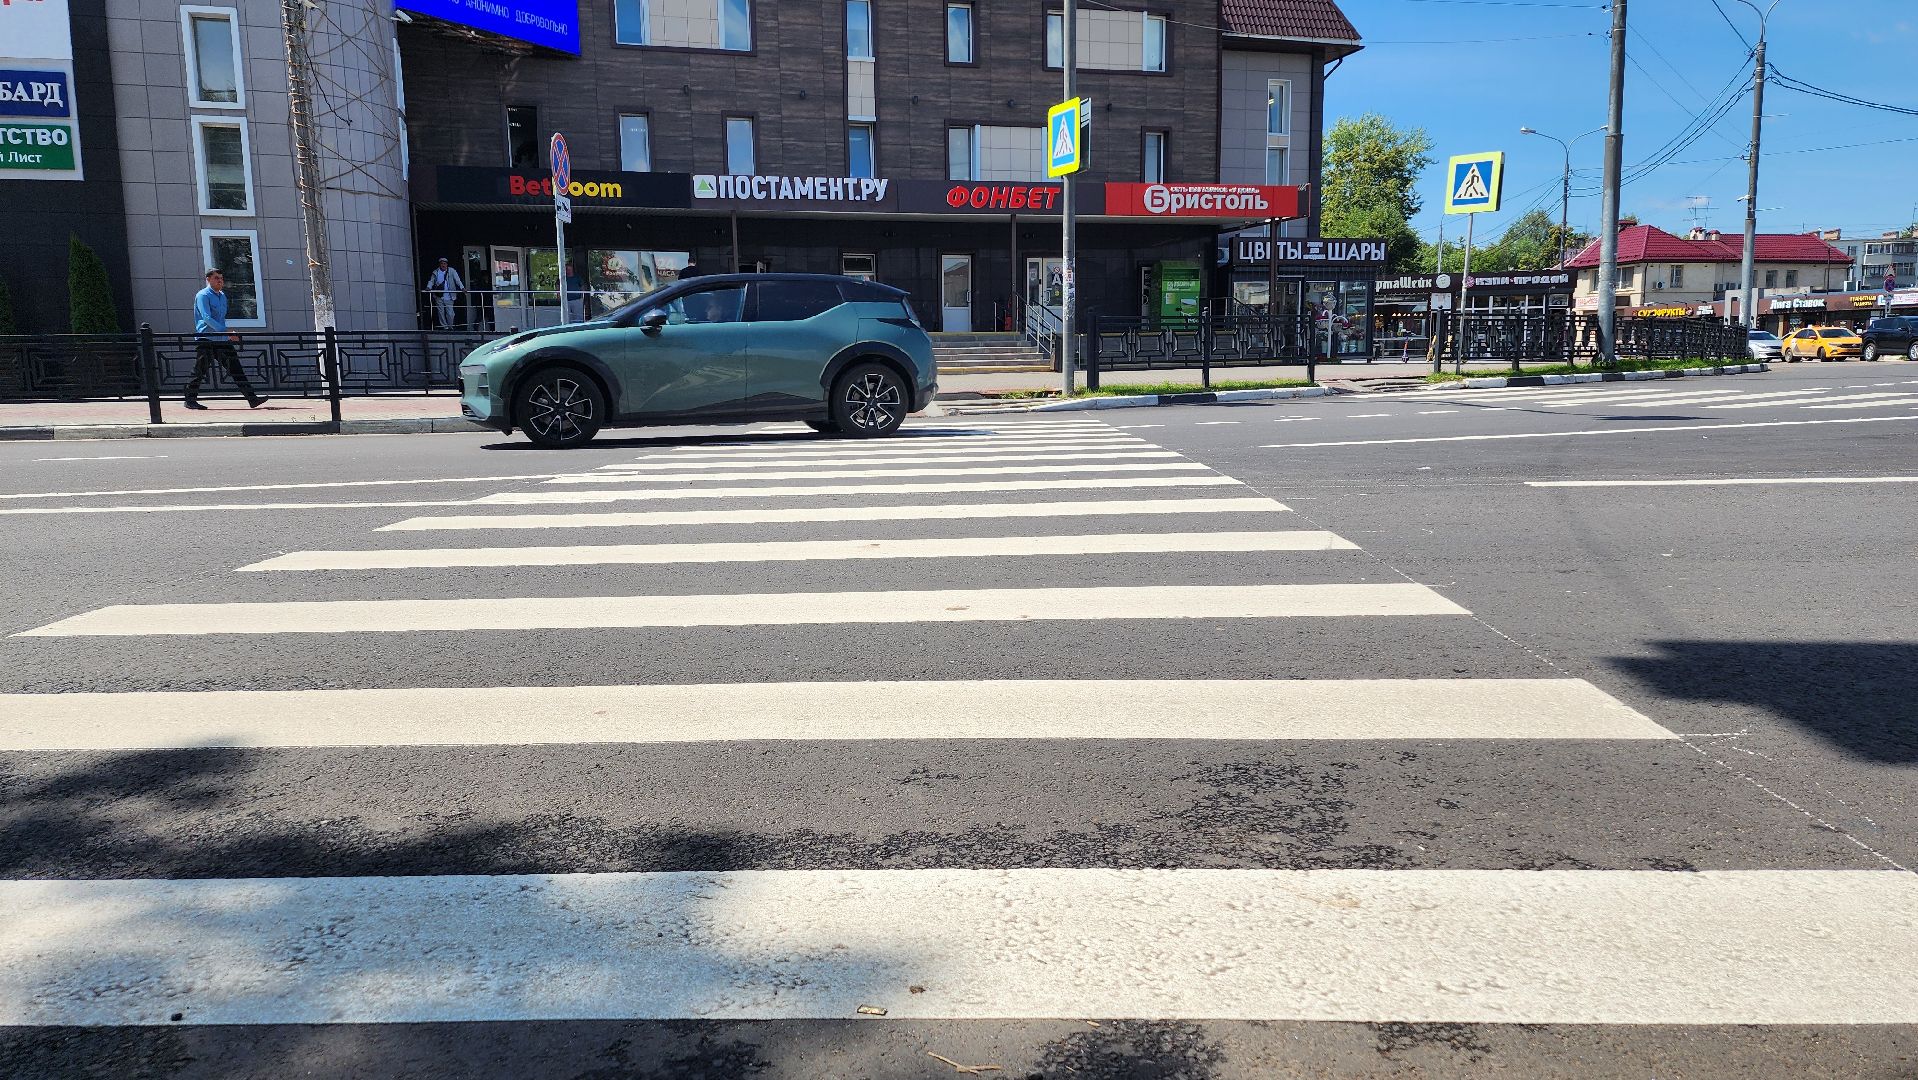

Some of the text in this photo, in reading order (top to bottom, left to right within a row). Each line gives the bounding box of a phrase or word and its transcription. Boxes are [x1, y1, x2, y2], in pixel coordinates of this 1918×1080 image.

[515, 9, 568, 36] ДОБРОВОЛЬНО
[8, 151, 43, 164] Лист
[510, 175, 622, 198] Betoom
[718, 175, 889, 202] ПОСТАМЕНТ.РУ
[946, 185, 1061, 209] ФОНБЕТ
[1144, 185, 1269, 214] Бристоль
[1327, 242, 1386, 261] ШАРЫ
[1769, 298, 1825, 310] Лига Ставок
